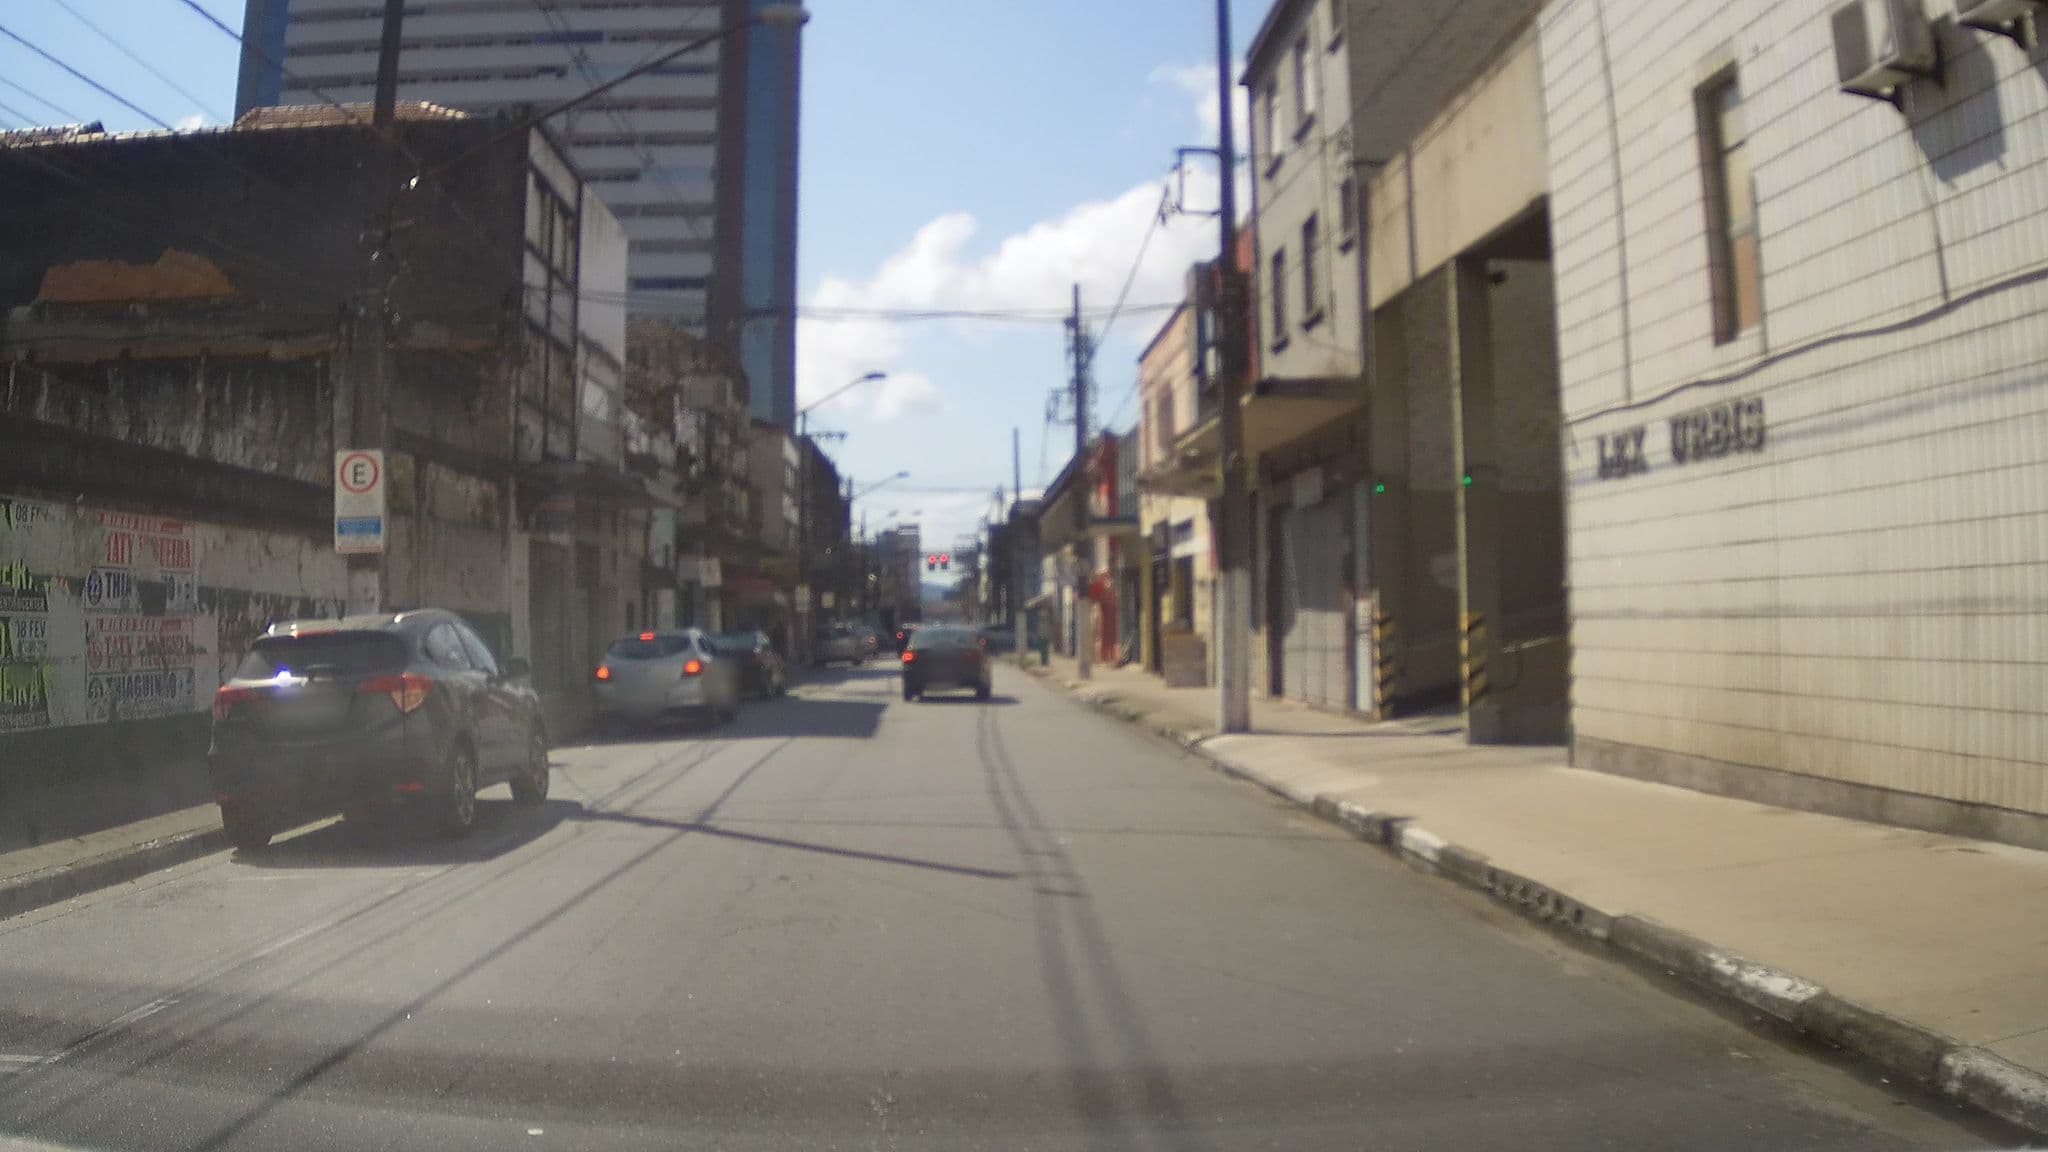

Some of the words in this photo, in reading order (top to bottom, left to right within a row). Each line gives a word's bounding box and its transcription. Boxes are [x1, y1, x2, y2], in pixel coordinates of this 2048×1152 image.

[1598, 424, 1648, 478] LEX
[1671, 398, 1765, 463] URBIS
[351, 463, 366, 486] E
[29, 620, 46, 639] FEV
